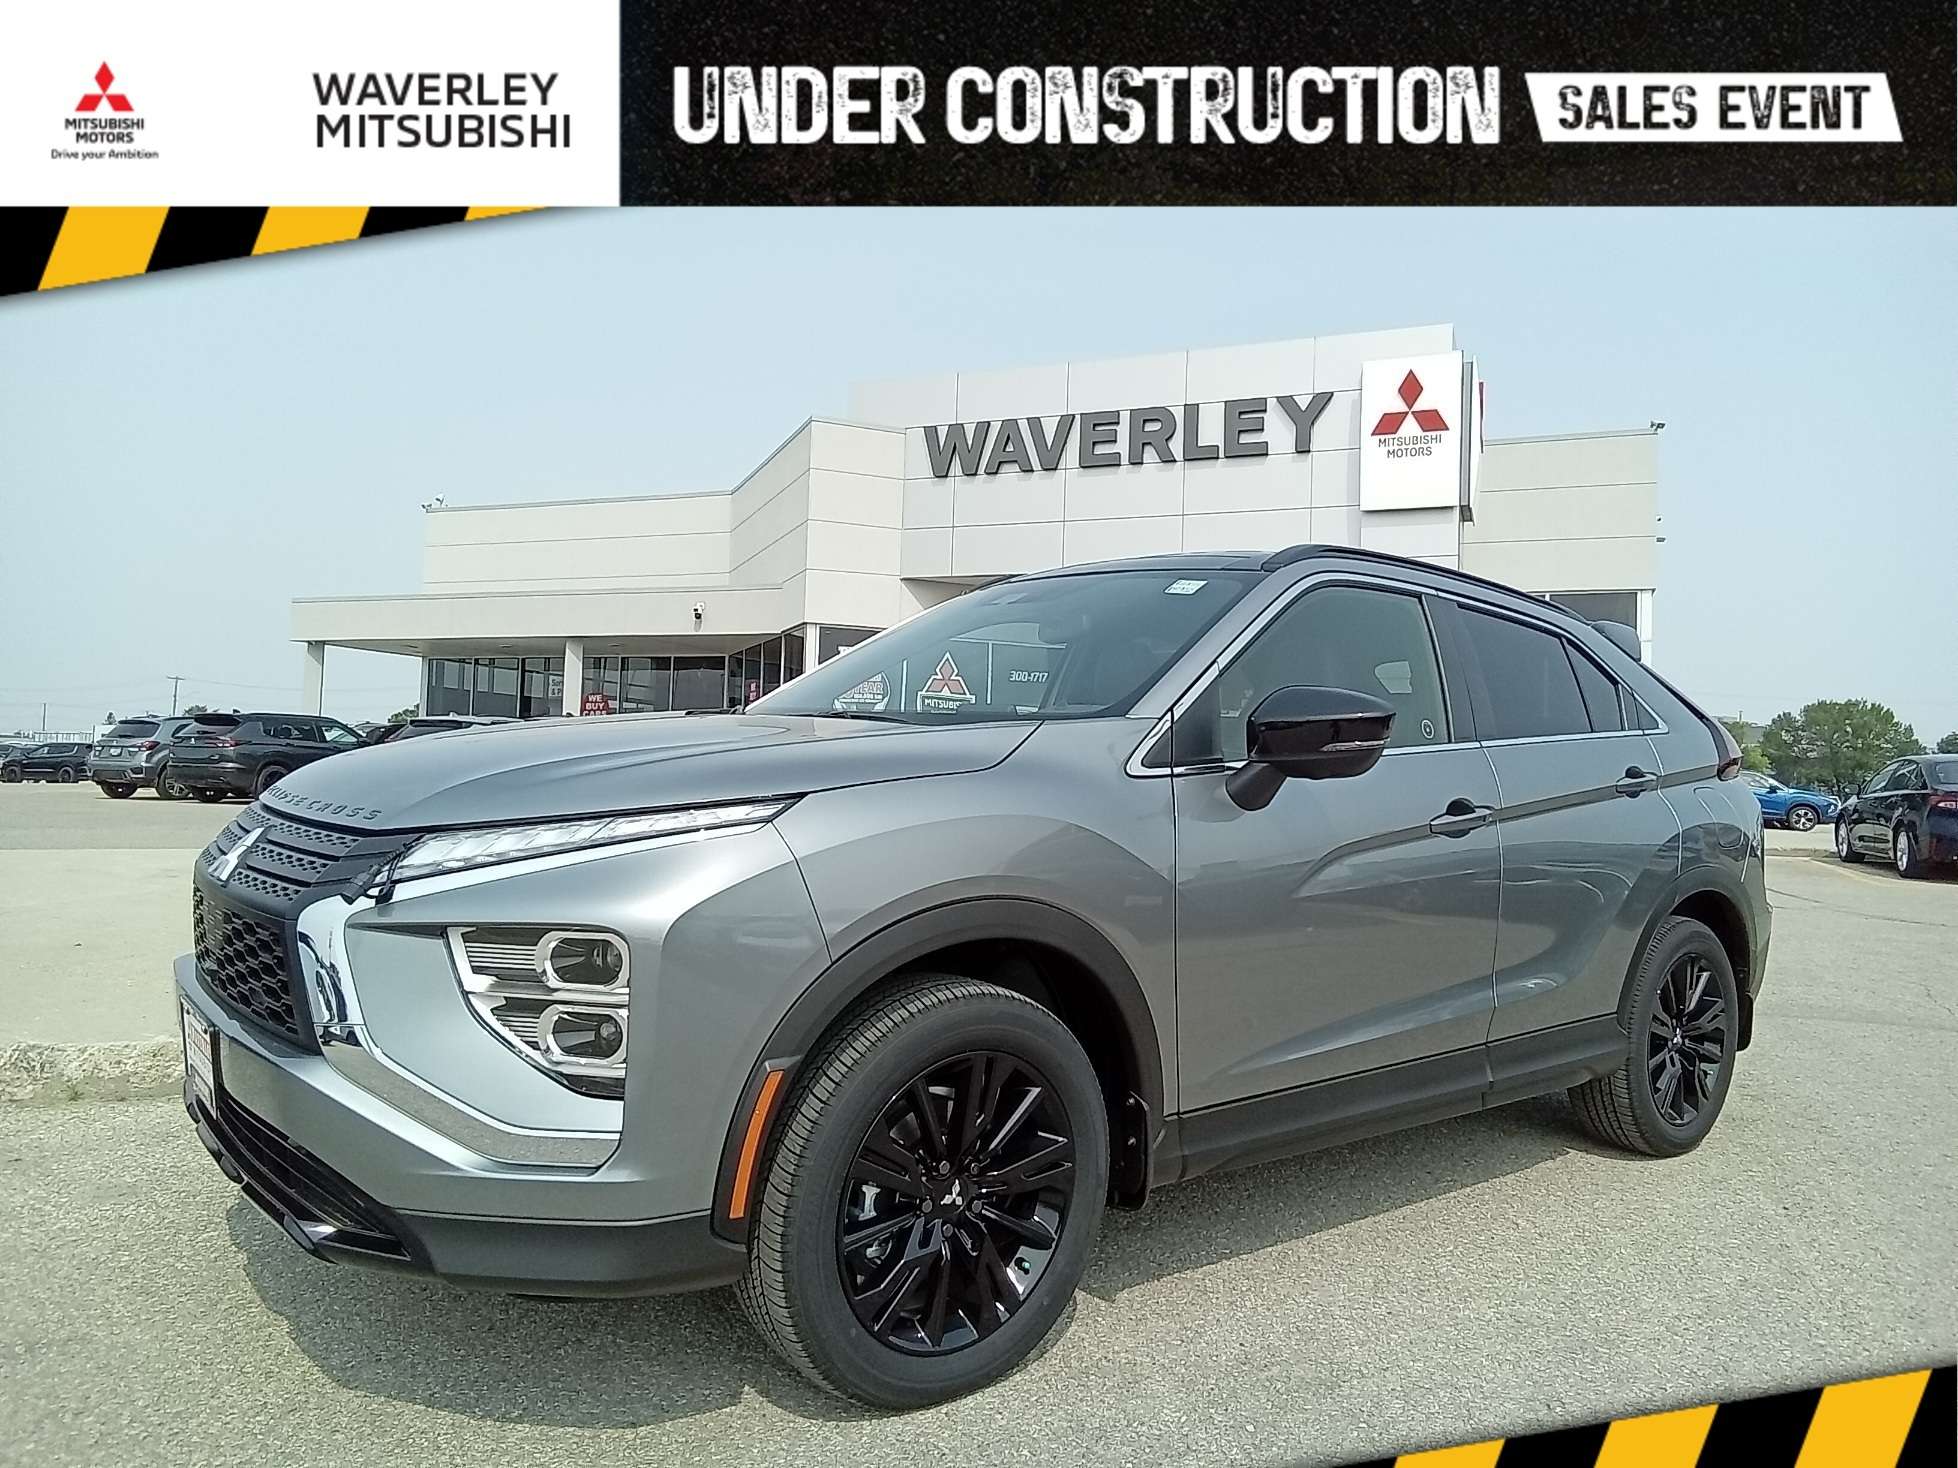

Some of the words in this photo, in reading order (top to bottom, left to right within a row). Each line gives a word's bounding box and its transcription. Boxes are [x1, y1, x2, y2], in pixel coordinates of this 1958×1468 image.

[924, 392, 1333, 478] WAVERLEY
[1378, 434, 1442, 448] MITSUBISHI
[1387, 446, 1432, 459] MOTORS
[588, 694, 603, 702] WE
[585, 702, 605, 710] BUY
[306, 799, 382, 821] CROSS
